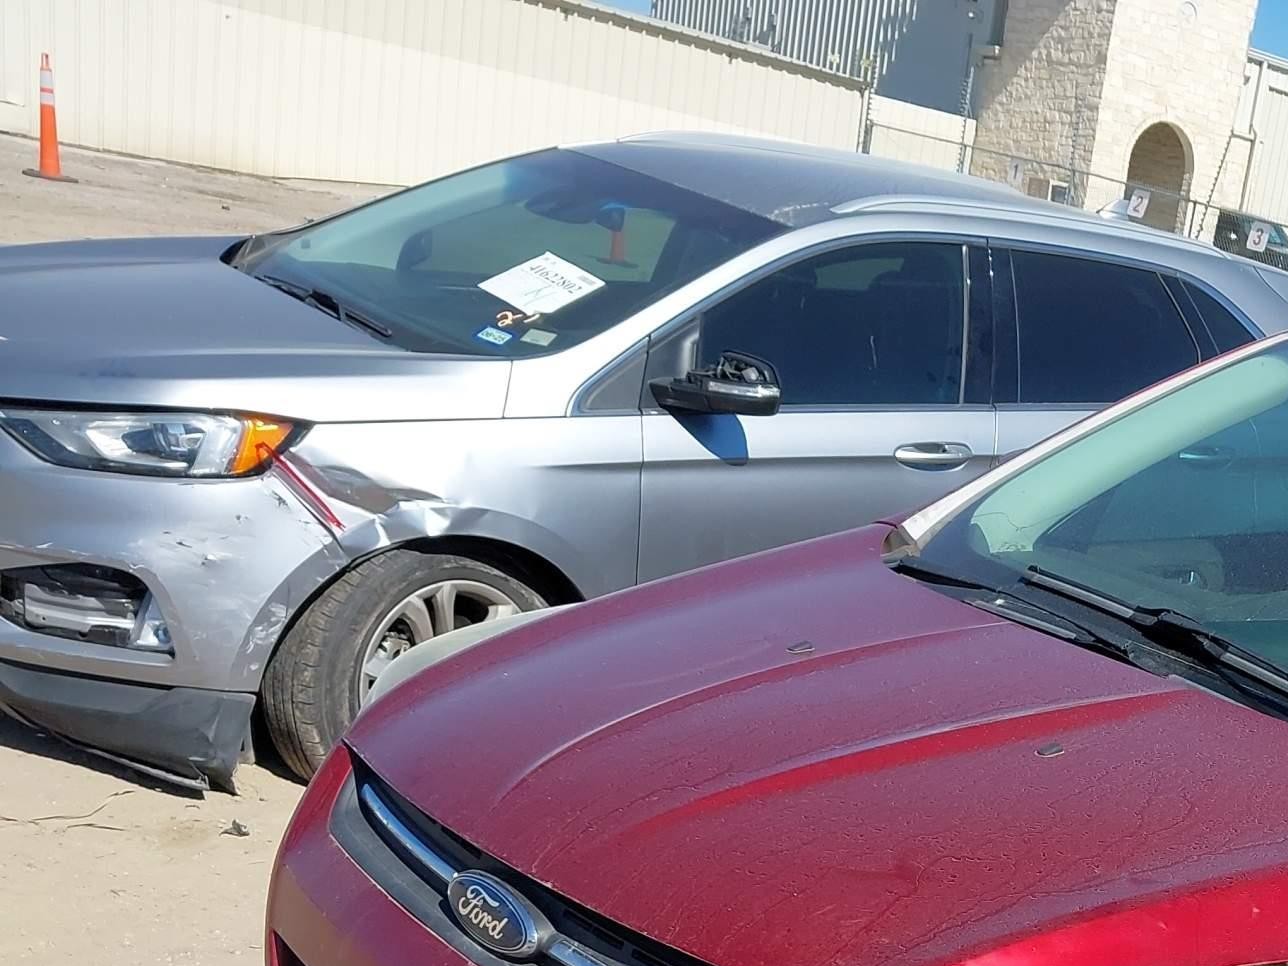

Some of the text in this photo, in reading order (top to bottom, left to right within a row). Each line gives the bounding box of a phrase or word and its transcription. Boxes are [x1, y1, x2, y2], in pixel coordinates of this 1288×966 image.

[1132, 194, 1144, 213] 2
[1252, 228, 1264, 246] 3
[459, 885, 509, 940] Ford
